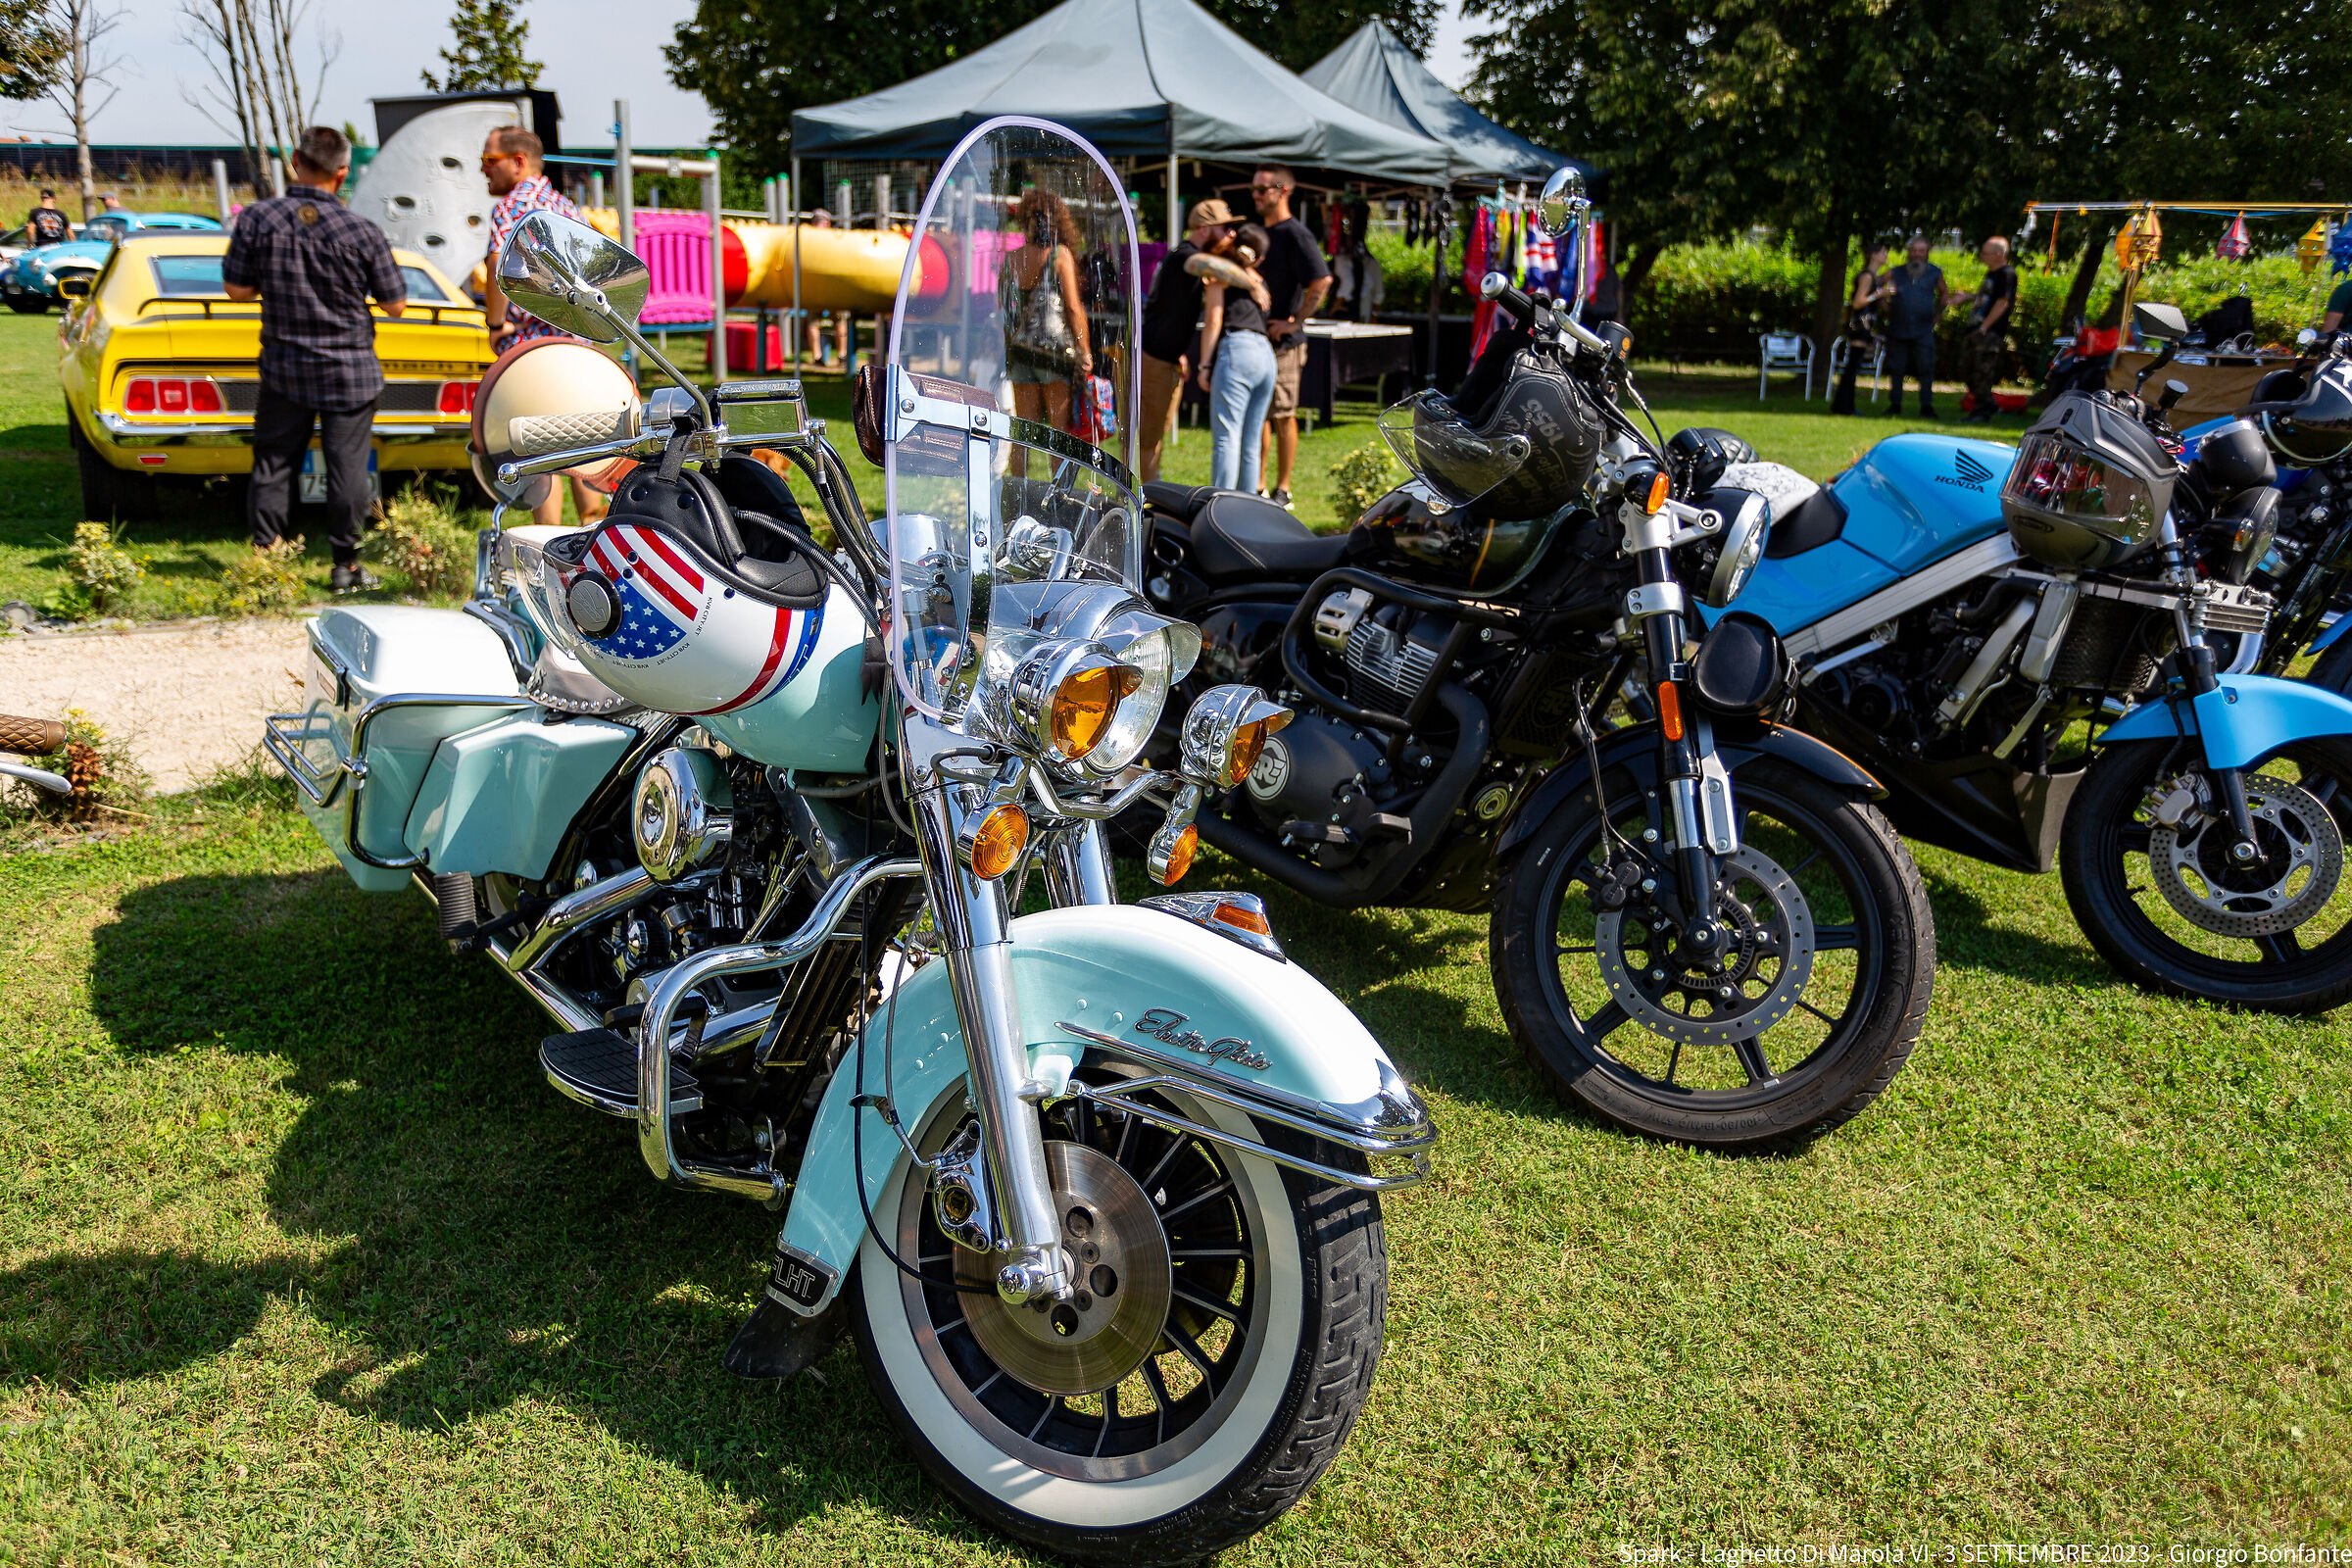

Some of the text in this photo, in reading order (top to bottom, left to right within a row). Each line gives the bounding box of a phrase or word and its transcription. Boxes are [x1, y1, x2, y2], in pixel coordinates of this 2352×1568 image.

[1935, 475, 1984, 494] HONDA
[1134, 1006, 1273, 1071] Electra Glide
